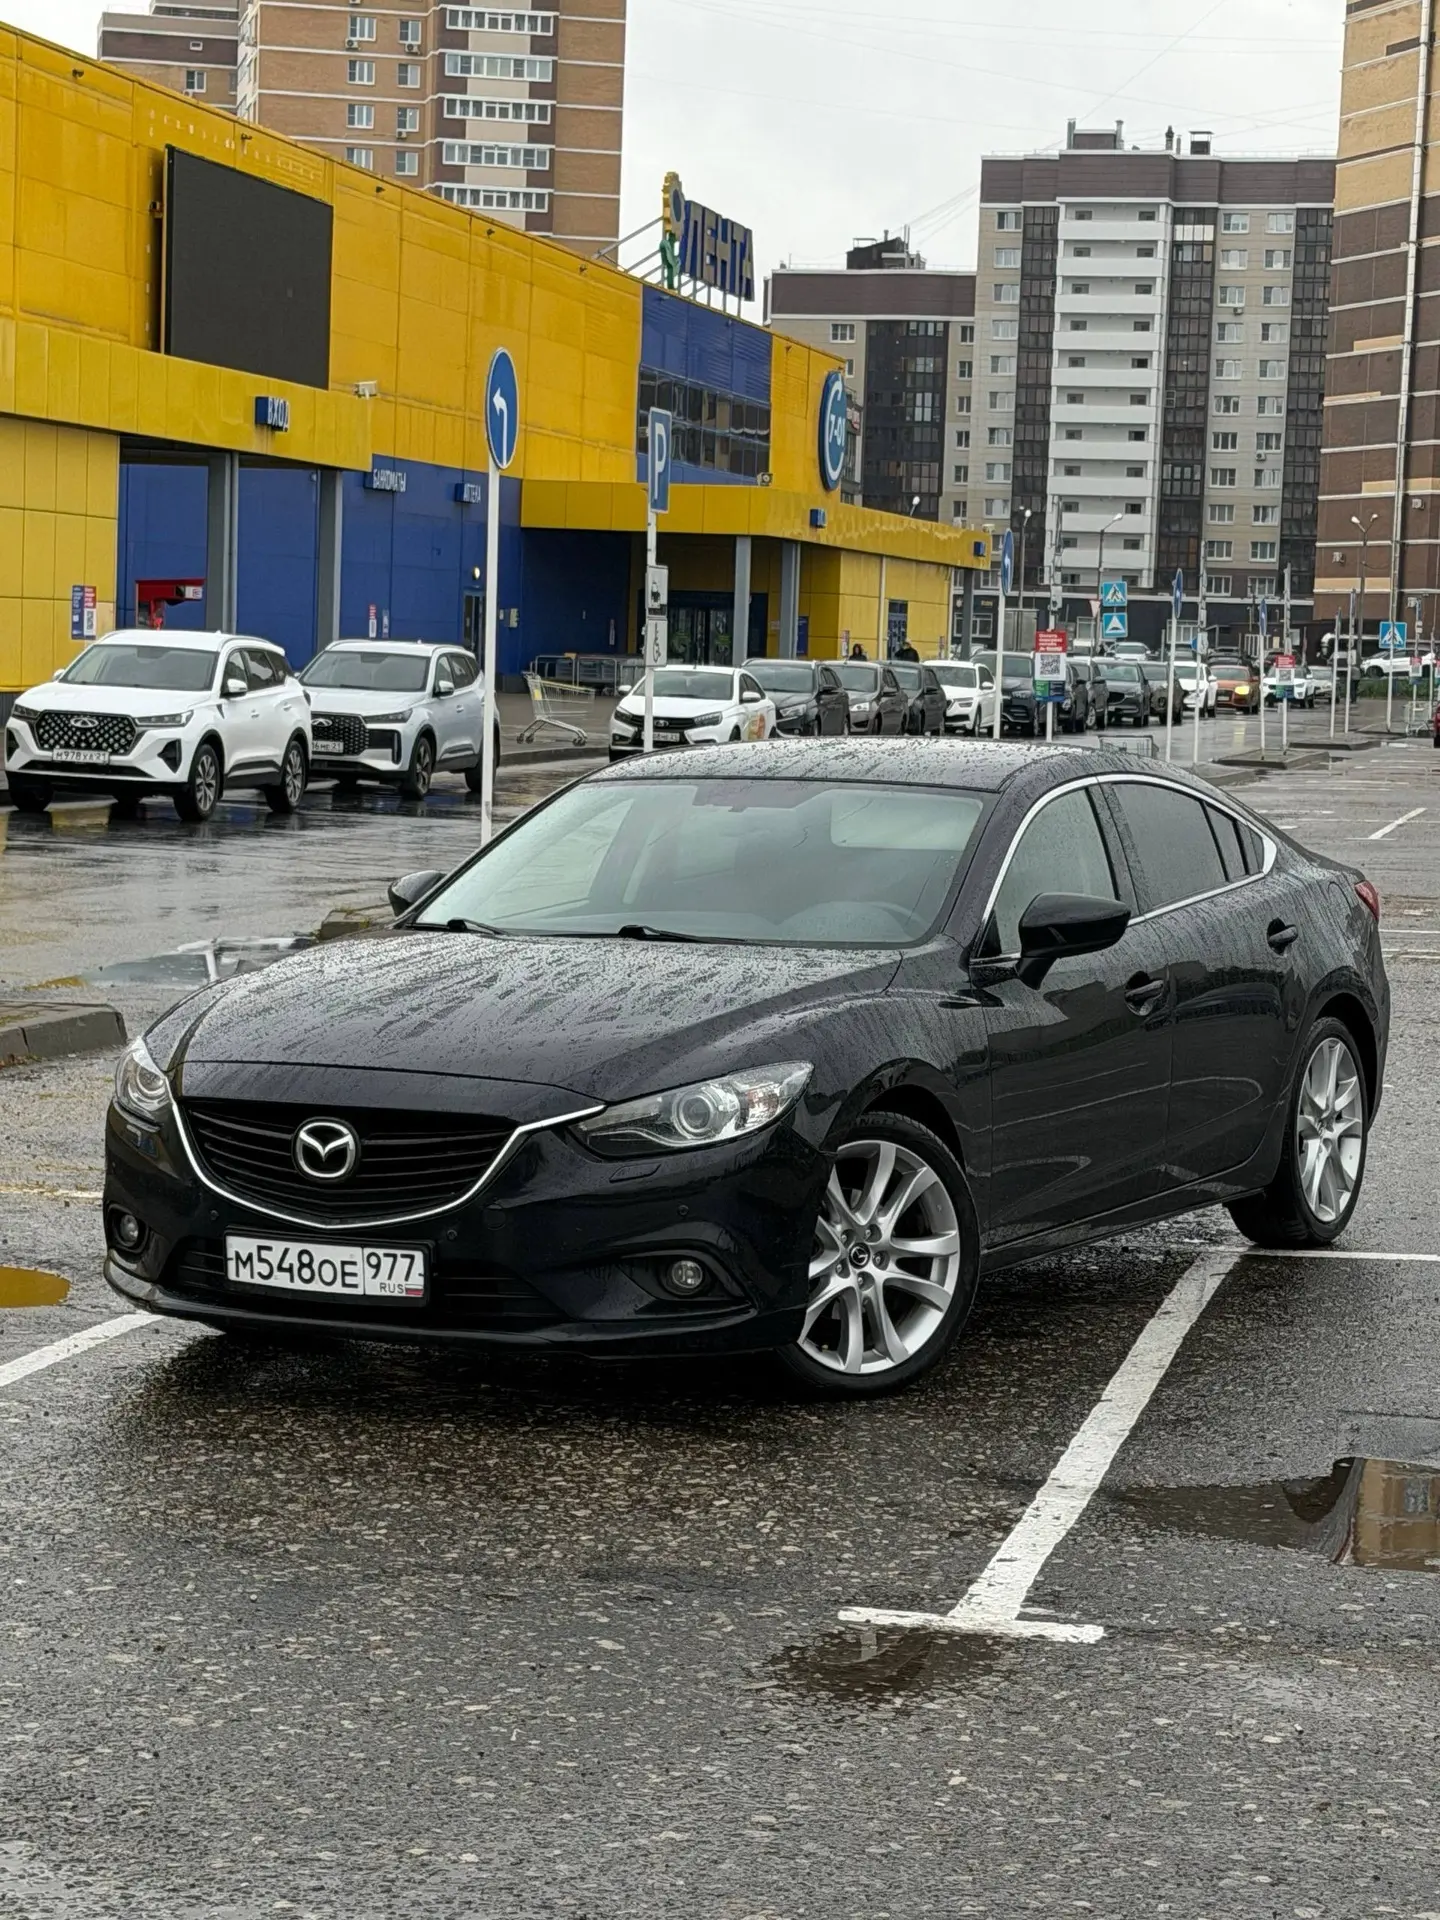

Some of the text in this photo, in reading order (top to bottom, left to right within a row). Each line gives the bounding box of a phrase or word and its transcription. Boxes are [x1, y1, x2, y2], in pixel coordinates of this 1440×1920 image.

[680, 200, 755, 302] ЛЕНТА
[267, 397, 289, 432] ВХОД
[655, 422, 667, 500] P
[234, 1245, 416, 1289] М548ОЕ 977
[379, 1282, 405, 1295] RUS
